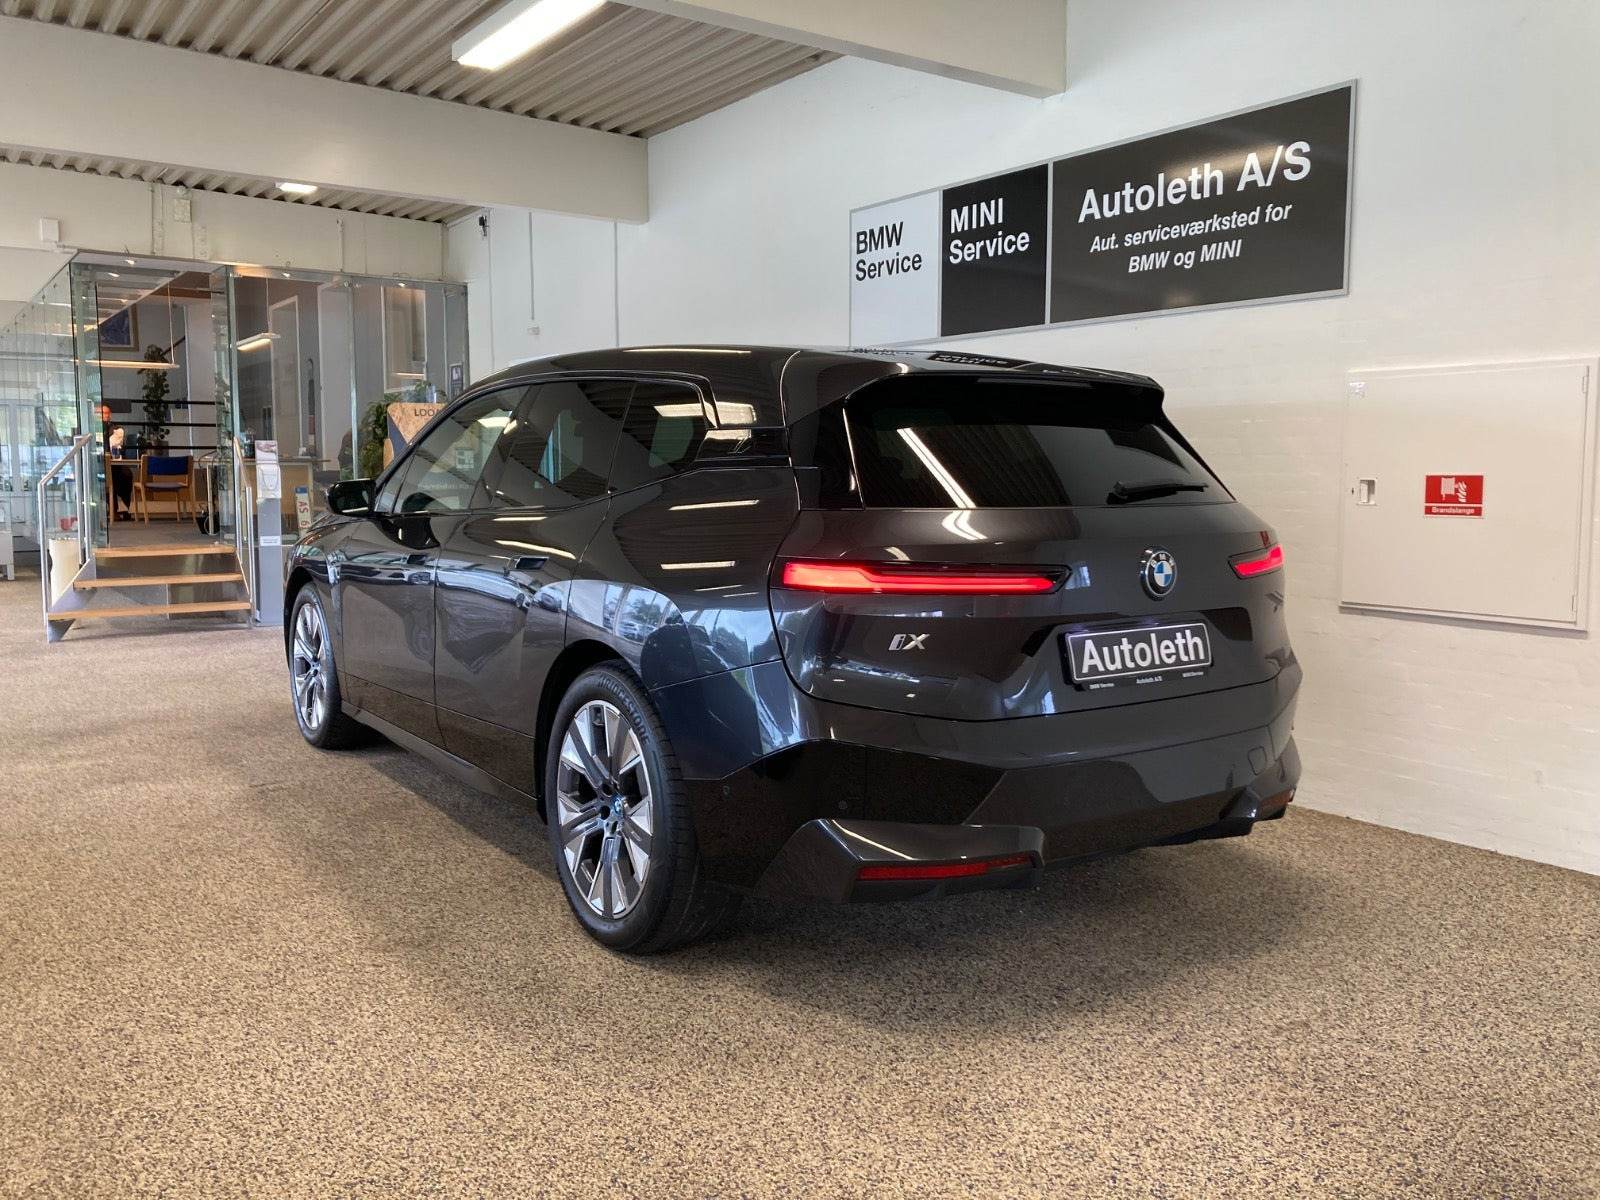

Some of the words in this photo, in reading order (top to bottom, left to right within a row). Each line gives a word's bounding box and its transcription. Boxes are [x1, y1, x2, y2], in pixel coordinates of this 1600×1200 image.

[1078, 163, 1224, 223] Autoleth
[1236, 141, 1311, 191] A/S
[950, 198, 1003, 234] MINI
[1090, 236, 1119, 252] Aut.
[1124, 206, 1260, 247] serviceværksted
[1264, 204, 1292, 223] for
[856, 221, 904, 255] BMW
[949, 231, 1030, 265] Service
[855, 251, 922, 282] Service
[1128, 250, 1169, 273] BMW
[1173, 251, 1195, 269] og
[1200, 239, 1242, 262] MINI
[414, 408, 440, 417] LOO
[1431, 506, 1475, 514] Brandslange
[1081, 629, 1205, 674] Autoleth
